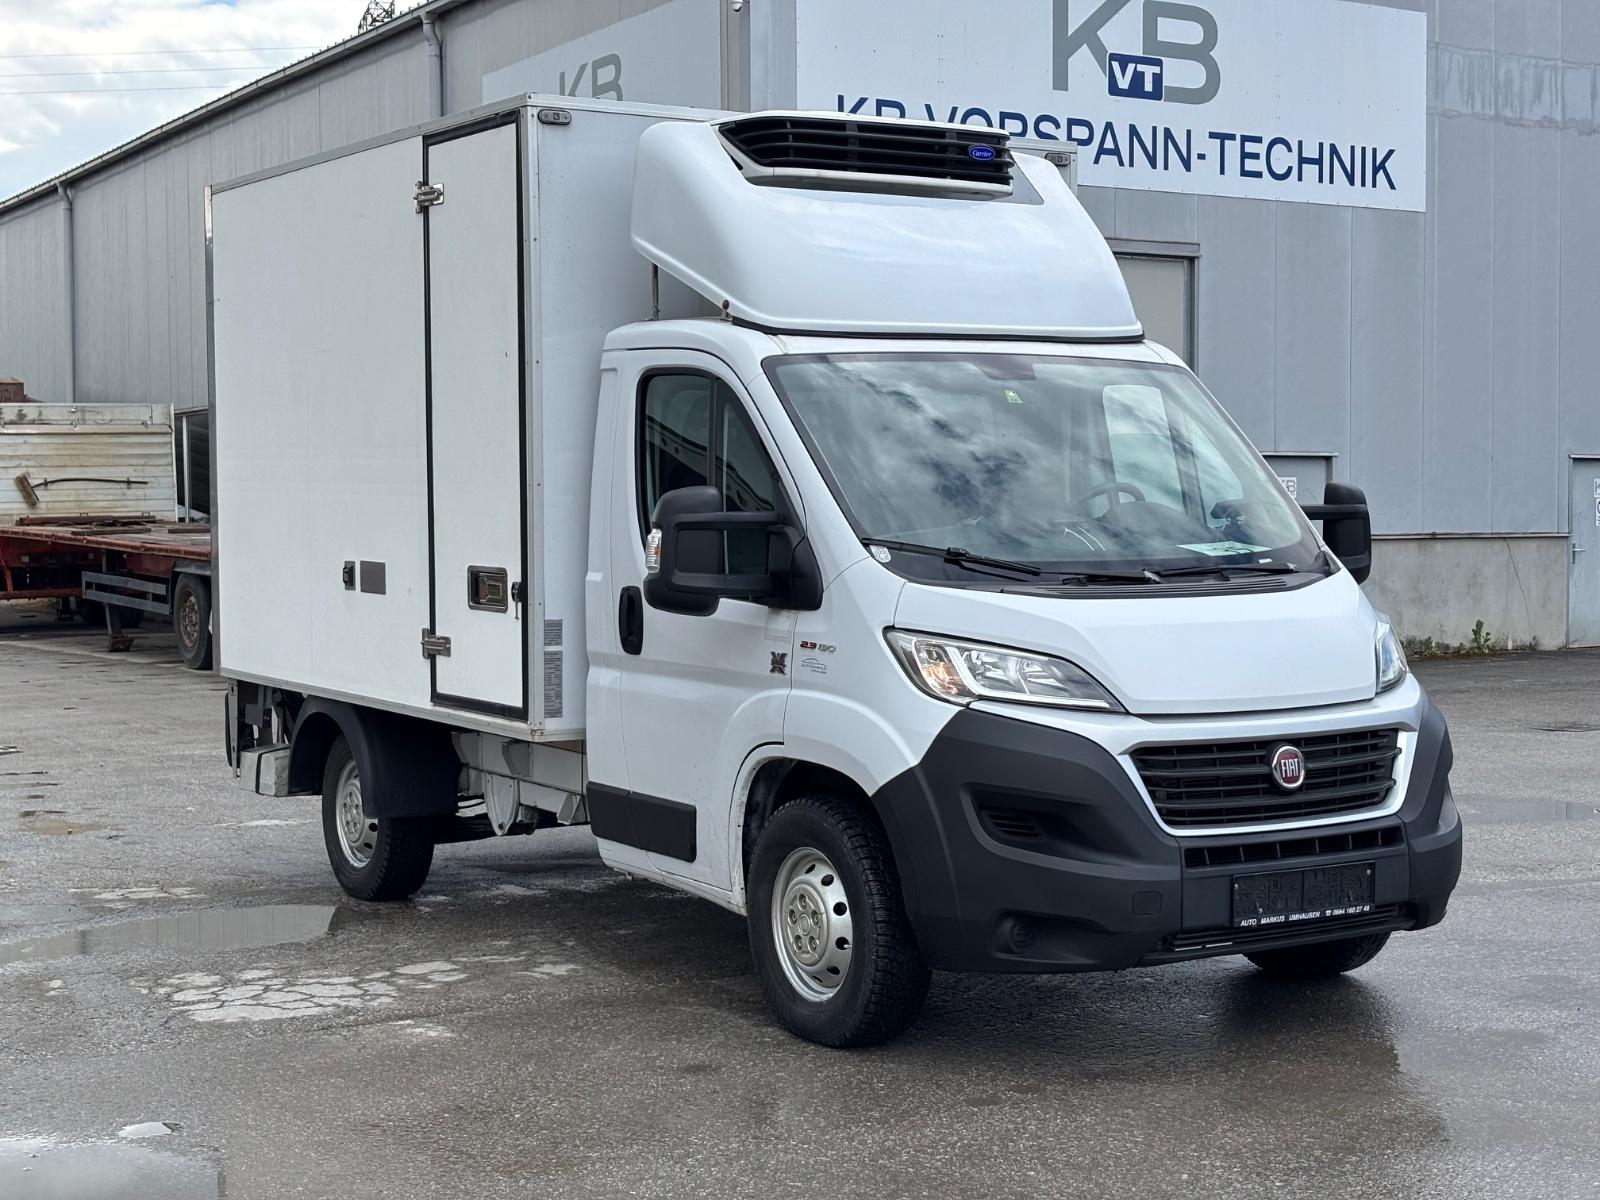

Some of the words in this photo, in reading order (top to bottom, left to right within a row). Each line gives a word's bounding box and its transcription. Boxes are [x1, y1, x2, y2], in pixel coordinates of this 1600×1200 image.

[1052, 0, 1221, 105] KB
[559, 53, 624, 101] KB
[1110, 60, 1161, 92] VT
[972, 149, 991, 157] Carrier
[1281, 758, 1299, 778] FIAT
[1240, 918, 1257, 926] AUTO
[1260, 915, 1285, 924] MARKUS
[1289, 911, 1320, 920] UMHAUSEN
